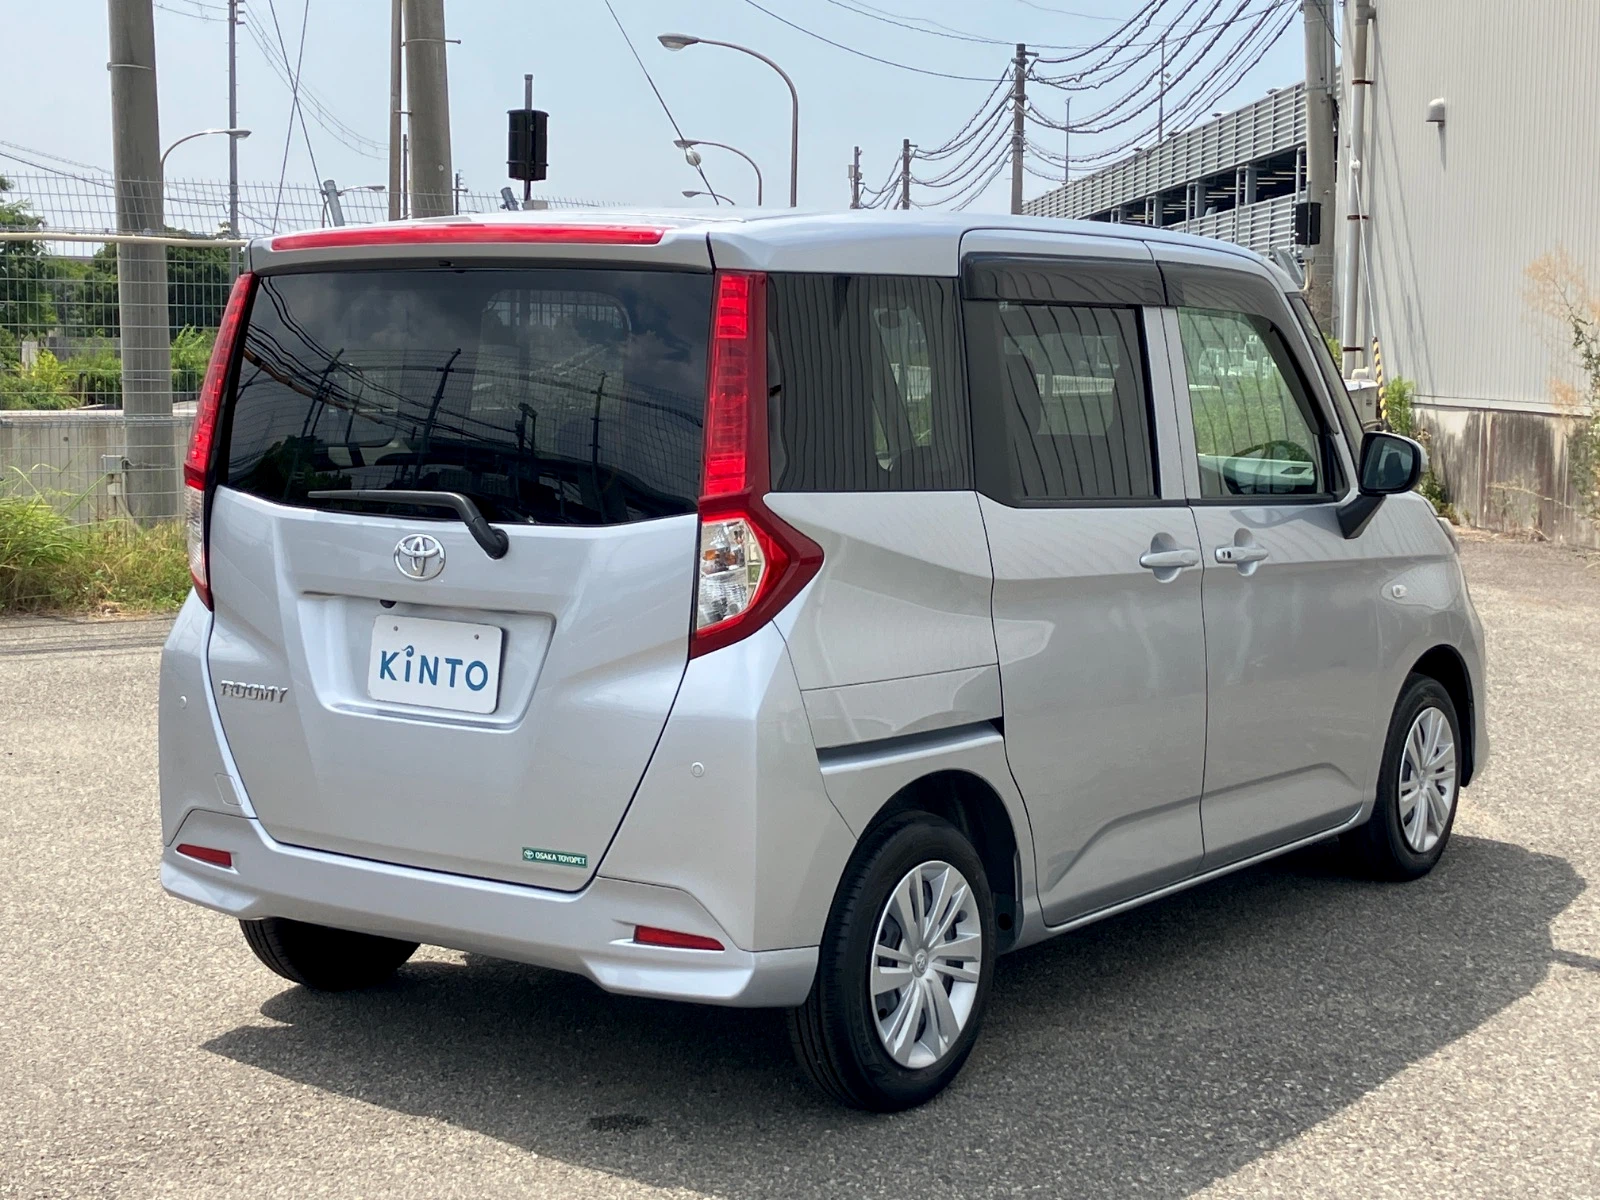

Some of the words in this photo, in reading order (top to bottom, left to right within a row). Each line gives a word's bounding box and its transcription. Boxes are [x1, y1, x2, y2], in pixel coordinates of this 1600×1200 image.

[221, 680, 288, 703] ROOMY
[535, 851, 557, 861] OSAKA
[557, 854, 585, 865] TOYOPET
